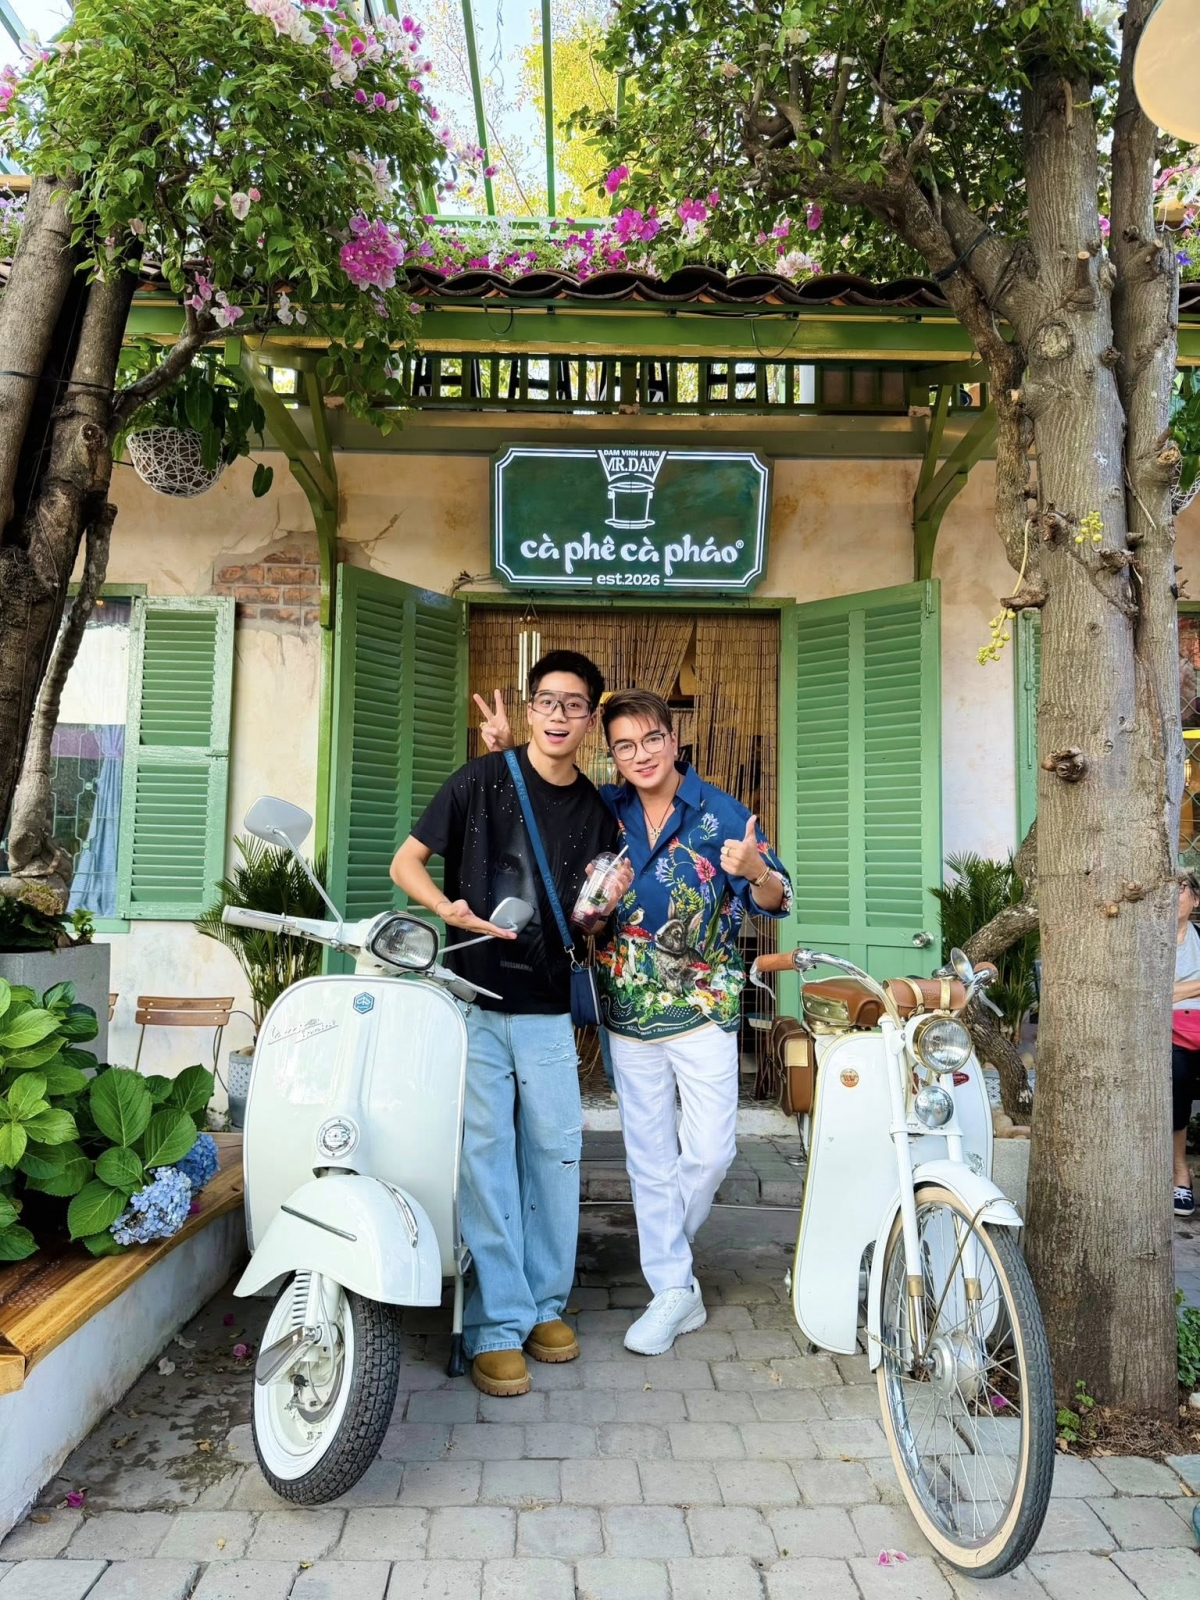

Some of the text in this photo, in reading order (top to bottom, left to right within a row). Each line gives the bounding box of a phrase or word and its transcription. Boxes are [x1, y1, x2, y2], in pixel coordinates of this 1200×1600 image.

[520, 533, 560, 560] cà
[564, 531, 616, 575] phê
[620, 536, 660, 563] cà
[596, 573, 660, 586] est.2026
[544, 871, 559, 906] TOMMY
